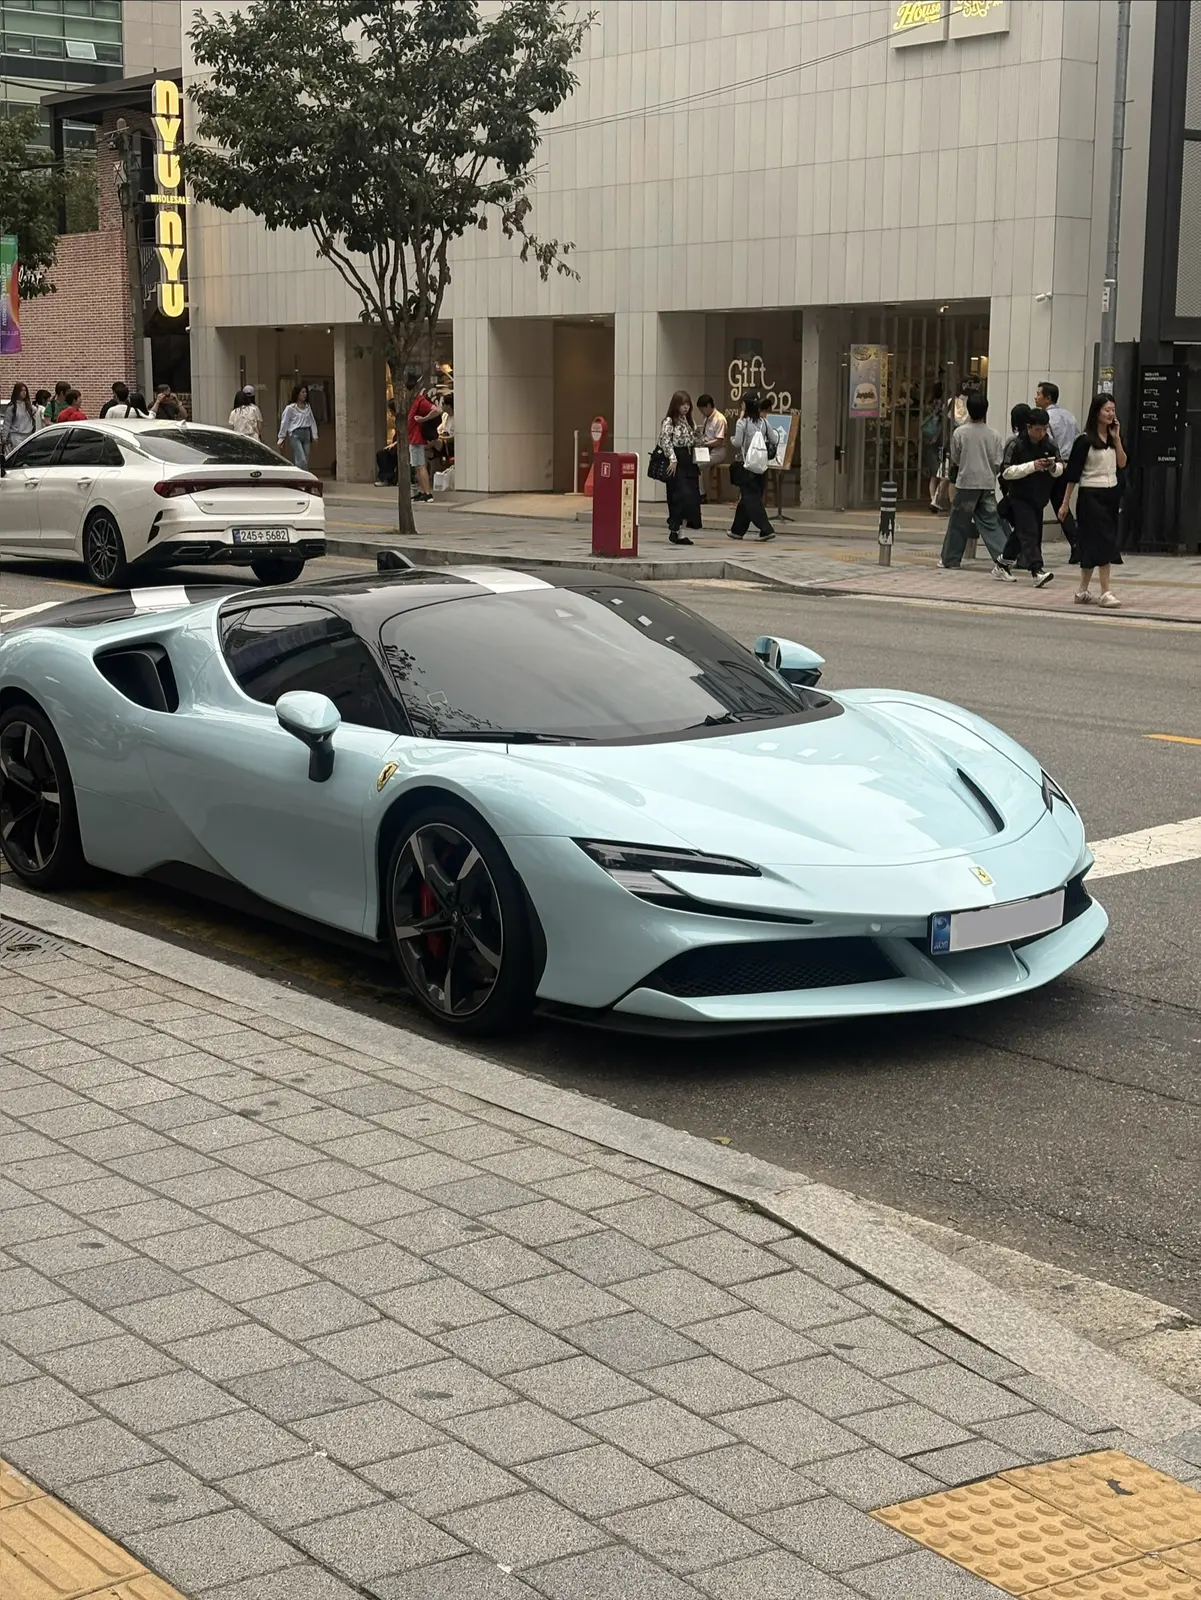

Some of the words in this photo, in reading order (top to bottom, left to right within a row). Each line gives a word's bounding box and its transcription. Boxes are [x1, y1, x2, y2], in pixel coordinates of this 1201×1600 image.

[150, 194, 191, 205] WHOLESALE
[728, 355, 775, 401] Gift
[241, 531, 264, 540] 245수
[265, 530, 286, 540] 5682
